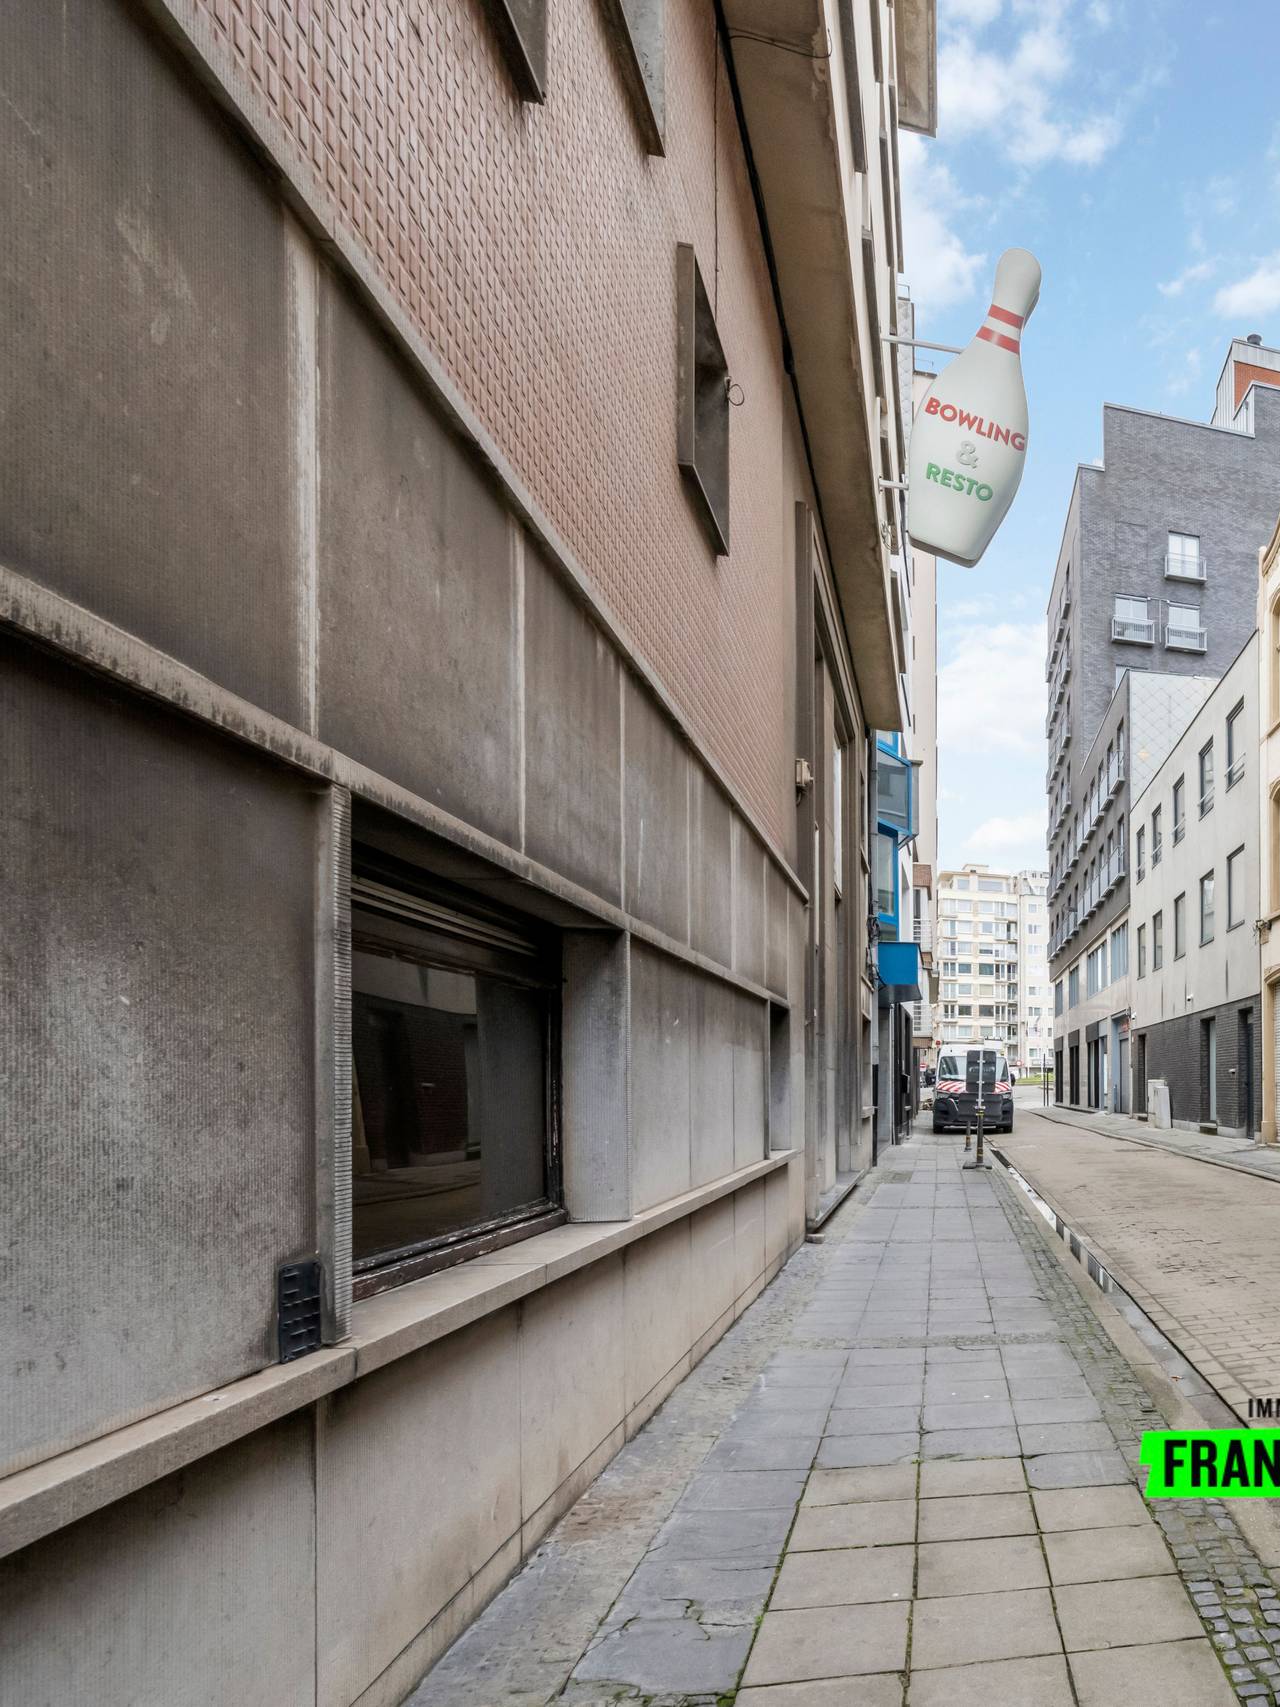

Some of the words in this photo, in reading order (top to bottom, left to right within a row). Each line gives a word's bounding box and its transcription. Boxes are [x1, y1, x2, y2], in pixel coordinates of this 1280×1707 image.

[925, 397, 1026, 451] BOWLING
[955, 441, 979, 469] &
[926, 463, 994, 502] RESTO
